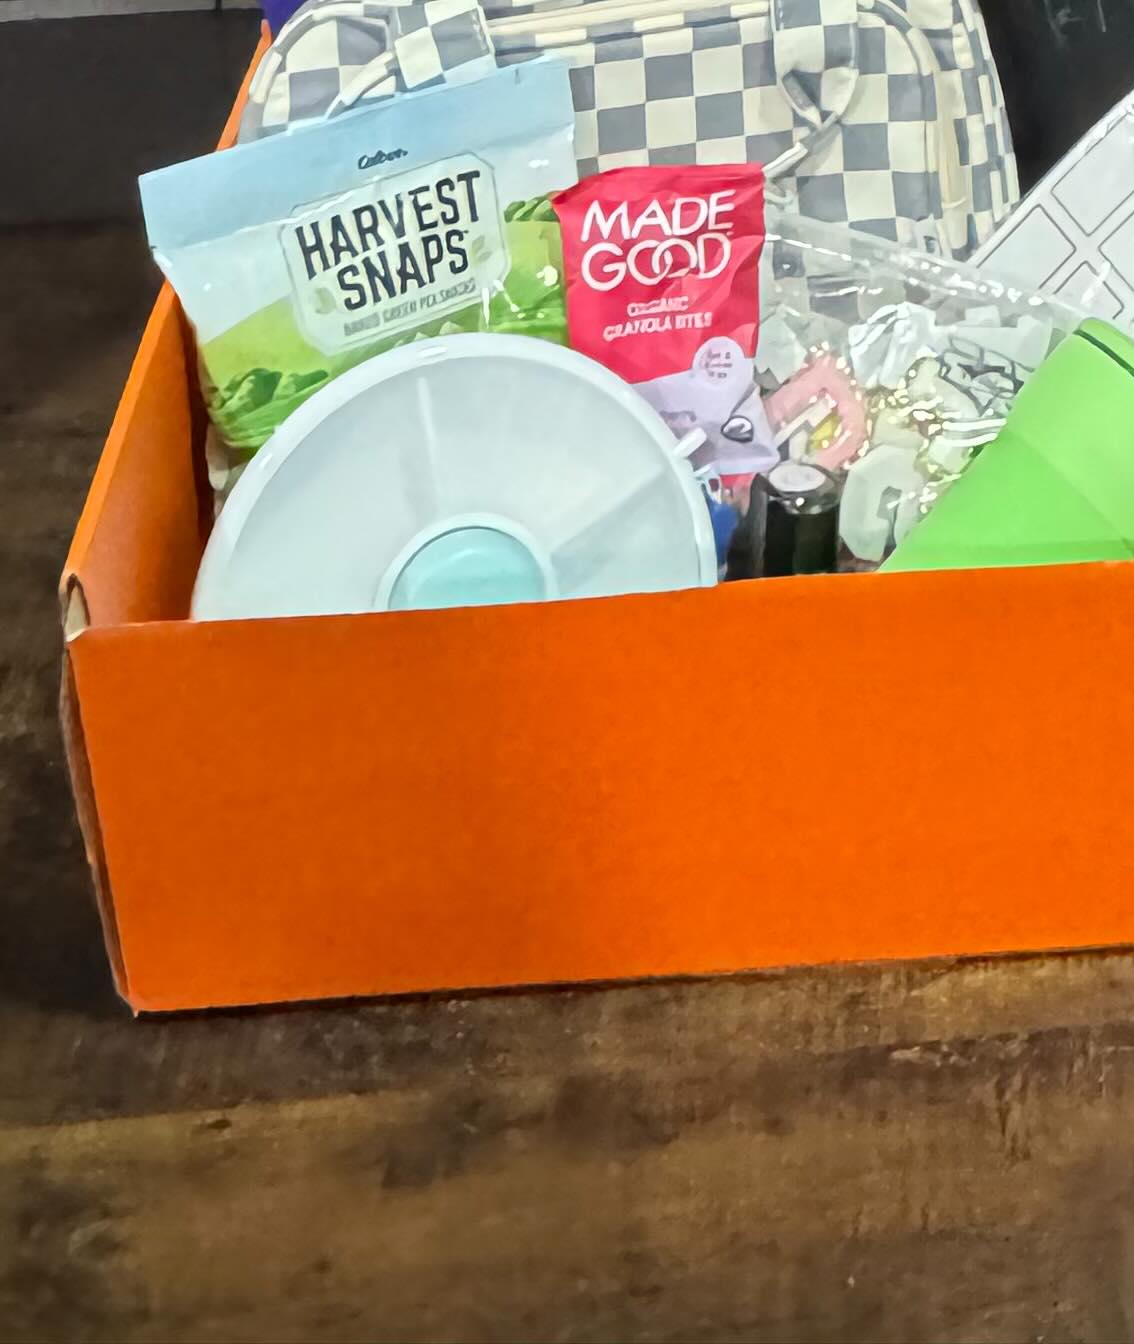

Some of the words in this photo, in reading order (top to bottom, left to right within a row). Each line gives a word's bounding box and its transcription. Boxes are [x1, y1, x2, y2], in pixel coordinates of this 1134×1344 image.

[294, 169, 483, 281] HARVEST
[579, 190, 736, 245] MADE
[336, 229, 471, 312] SNAPS
[581, 231, 732, 292] GOOD
